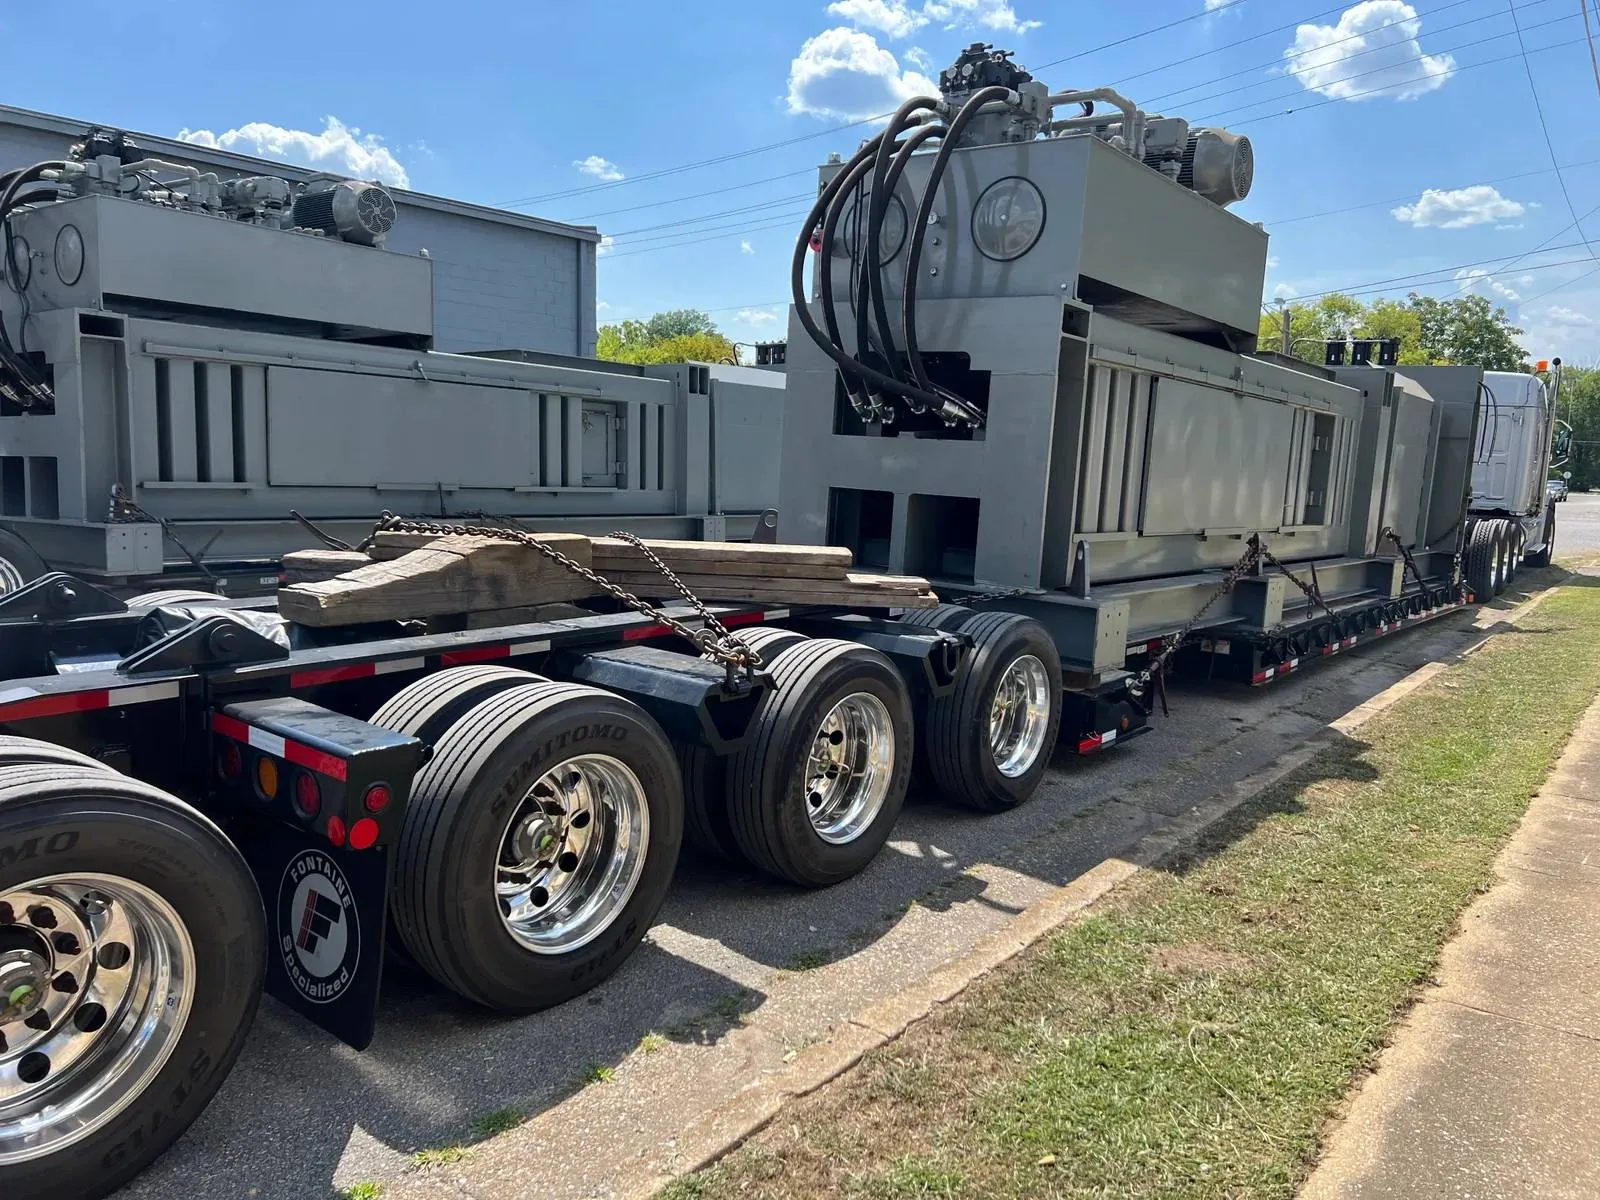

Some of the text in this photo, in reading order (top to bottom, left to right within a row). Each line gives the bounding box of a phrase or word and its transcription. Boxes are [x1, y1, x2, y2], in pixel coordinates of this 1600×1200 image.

[491, 724, 629, 816] SUMITOMO
[290, 856, 351, 909] FONTAINE
[283, 934, 350, 997] Specialized
